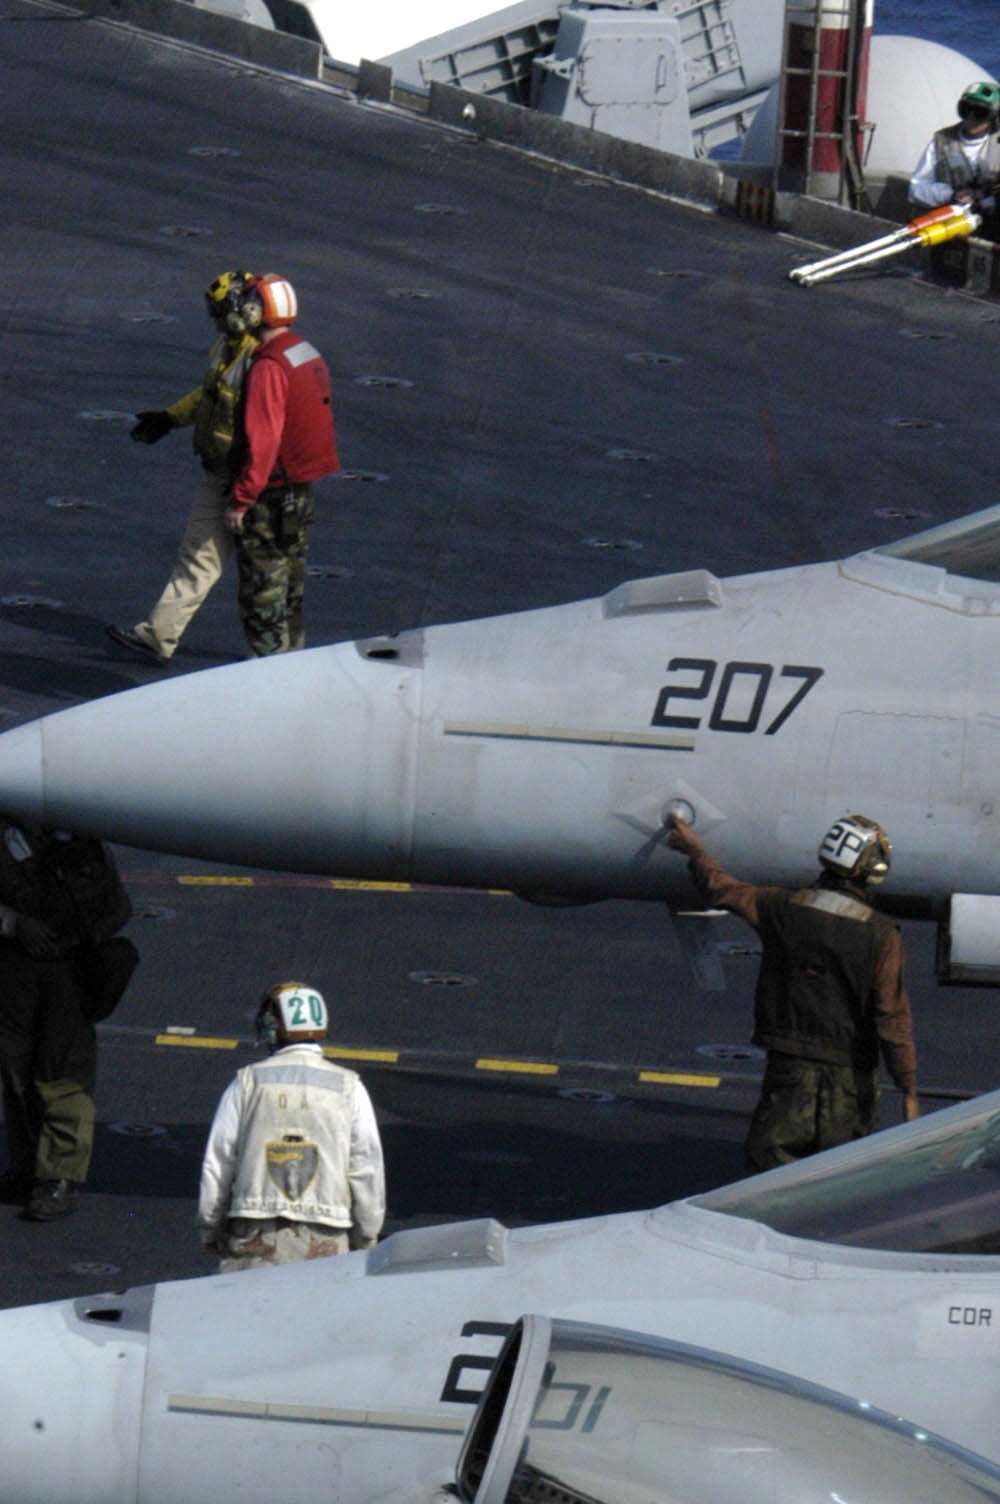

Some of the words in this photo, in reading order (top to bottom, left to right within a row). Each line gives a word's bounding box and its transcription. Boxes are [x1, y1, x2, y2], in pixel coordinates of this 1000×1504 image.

[650, 656, 825, 736] 207
[822, 823, 865, 857] 2P
[287, 994, 323, 1027] 2Q
[948, 1306, 993, 1327] CDR
